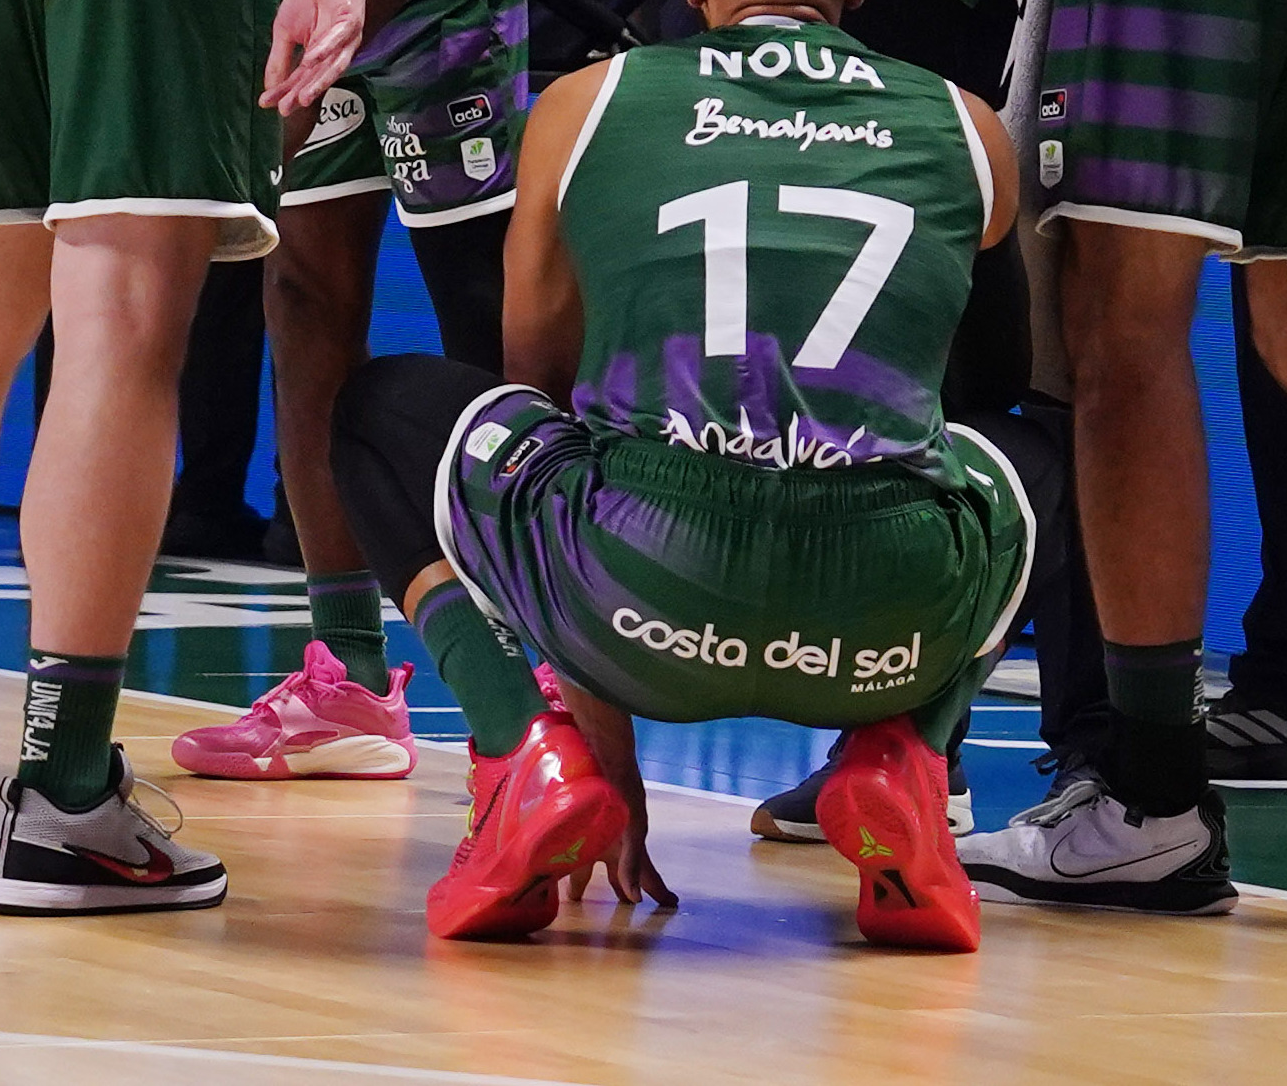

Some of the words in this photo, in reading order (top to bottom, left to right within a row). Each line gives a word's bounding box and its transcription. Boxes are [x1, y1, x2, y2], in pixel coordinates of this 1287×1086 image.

[699, 41, 886, 89] NOUA
[455, 107, 483, 123] acb
[1042, 101, 1060, 117] acb
[657, 180, 915, 370] 17
[612, 607, 748, 668] costa
[763, 630, 842, 678] del
[854, 632, 922, 680] sol
[850, 673, 917, 694] MÁLAGA
